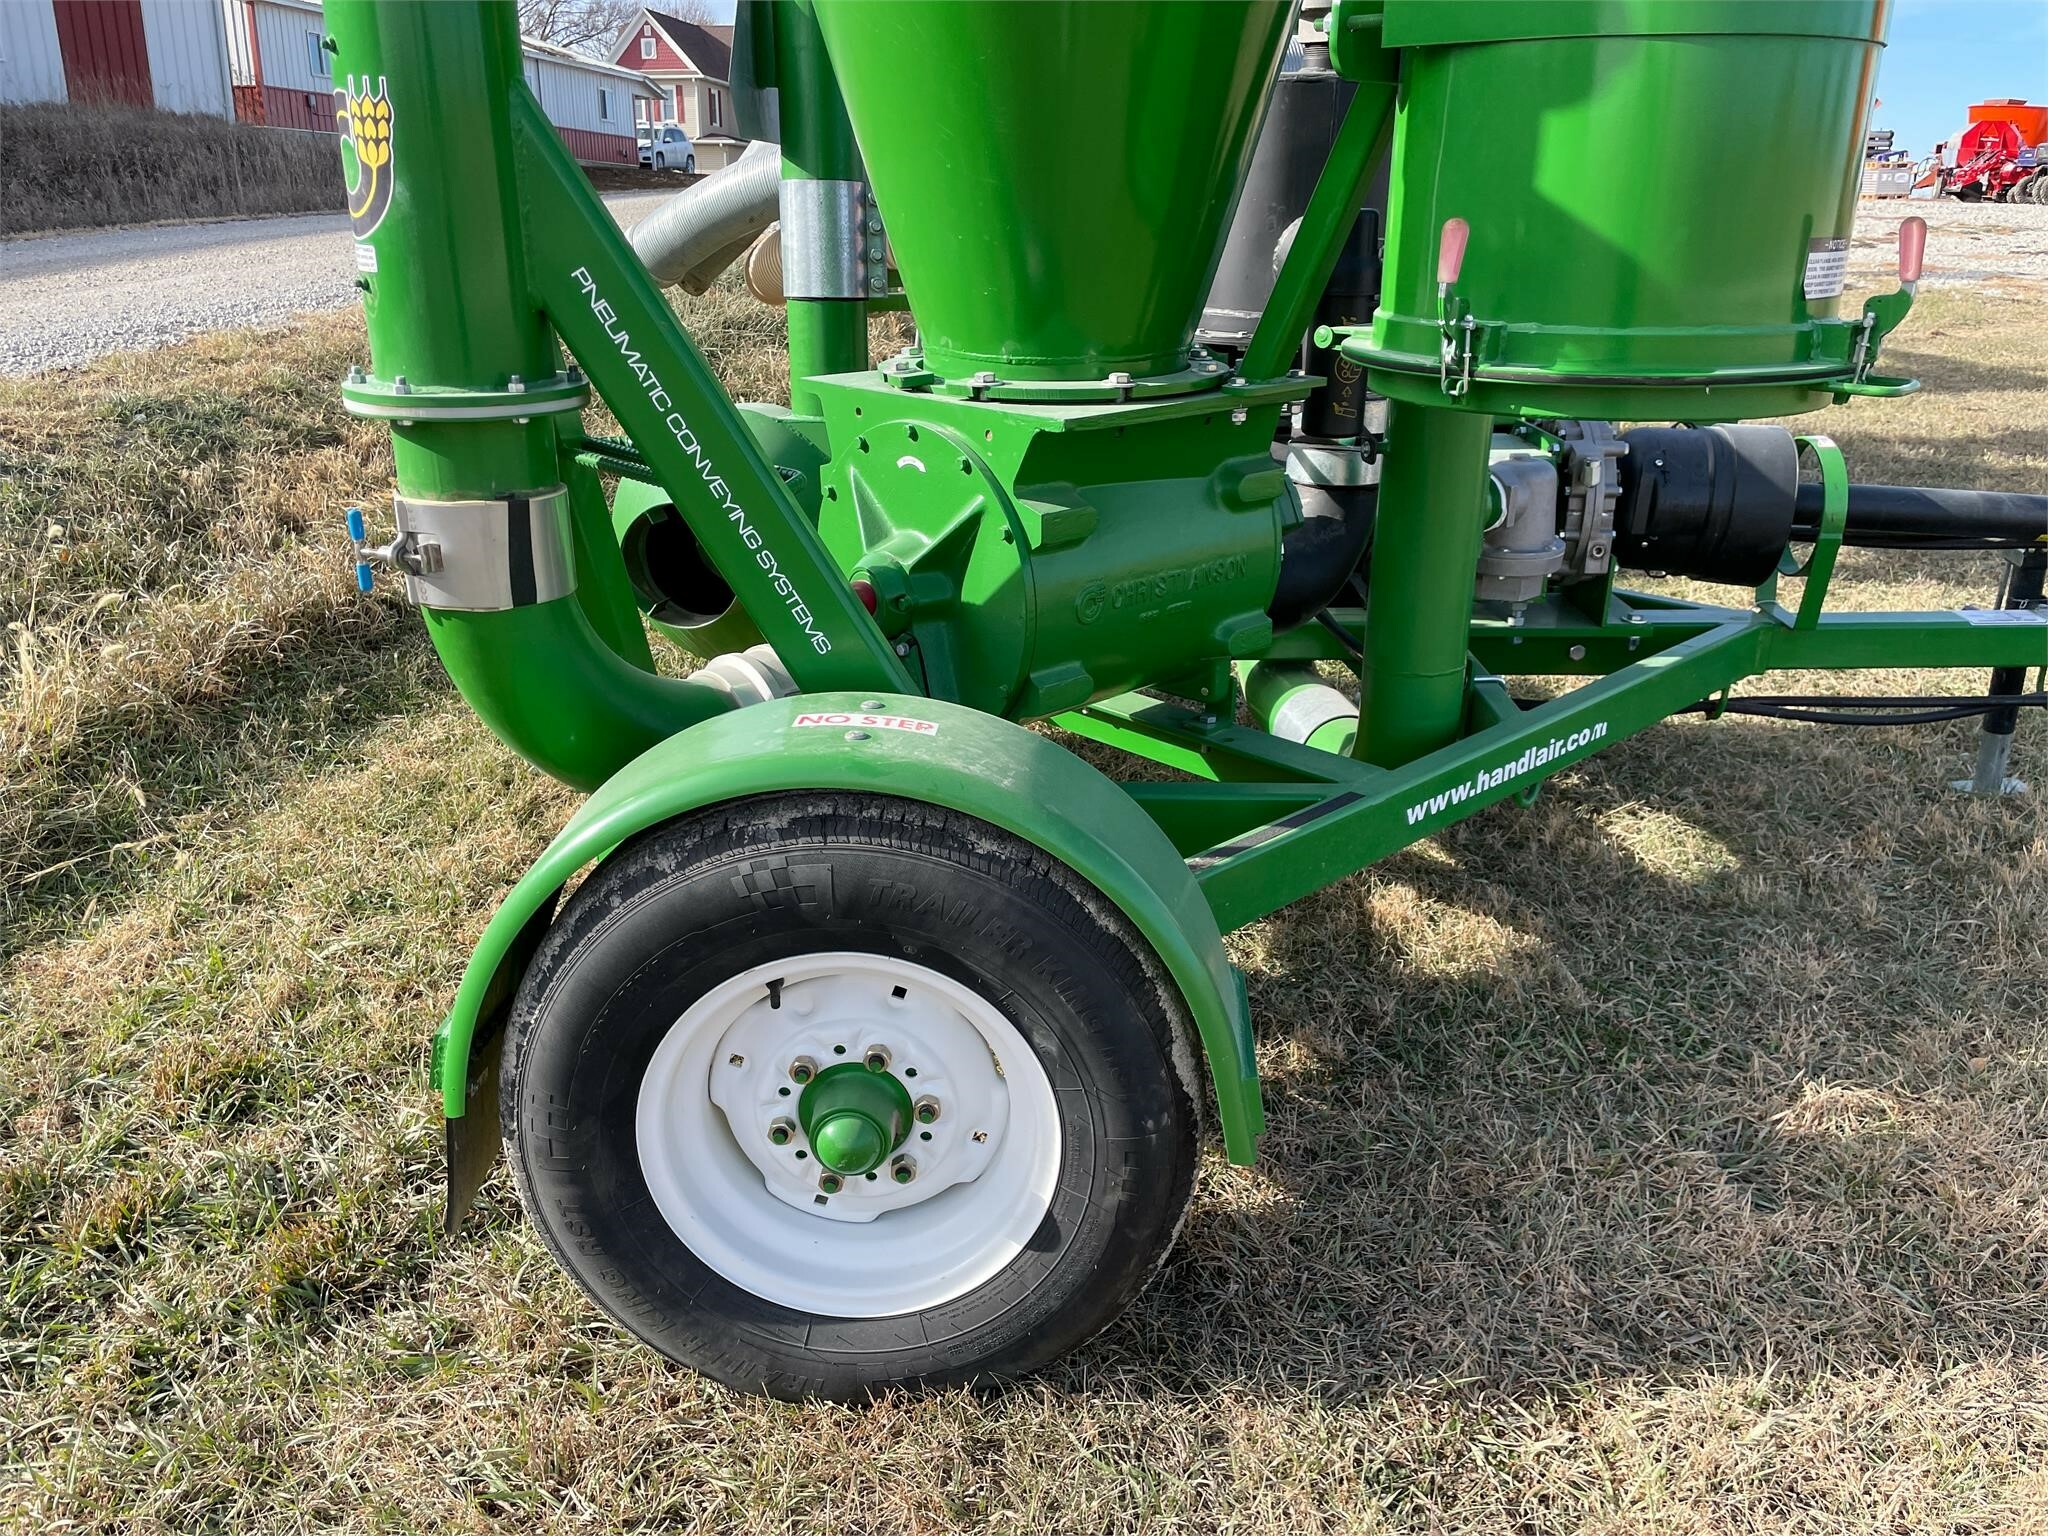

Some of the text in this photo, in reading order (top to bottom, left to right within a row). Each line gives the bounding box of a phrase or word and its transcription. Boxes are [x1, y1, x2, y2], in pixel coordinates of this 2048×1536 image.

[571, 266, 832, 655] PNEUMATIC CONVEYING SYSTEMS
[1111, 552, 1249, 610] CHRISTIANSON
[798, 714, 935, 731] NO STEP
[1406, 721, 1608, 826] www.handlair.com
[867, 878, 1033, 959] TRAILER
